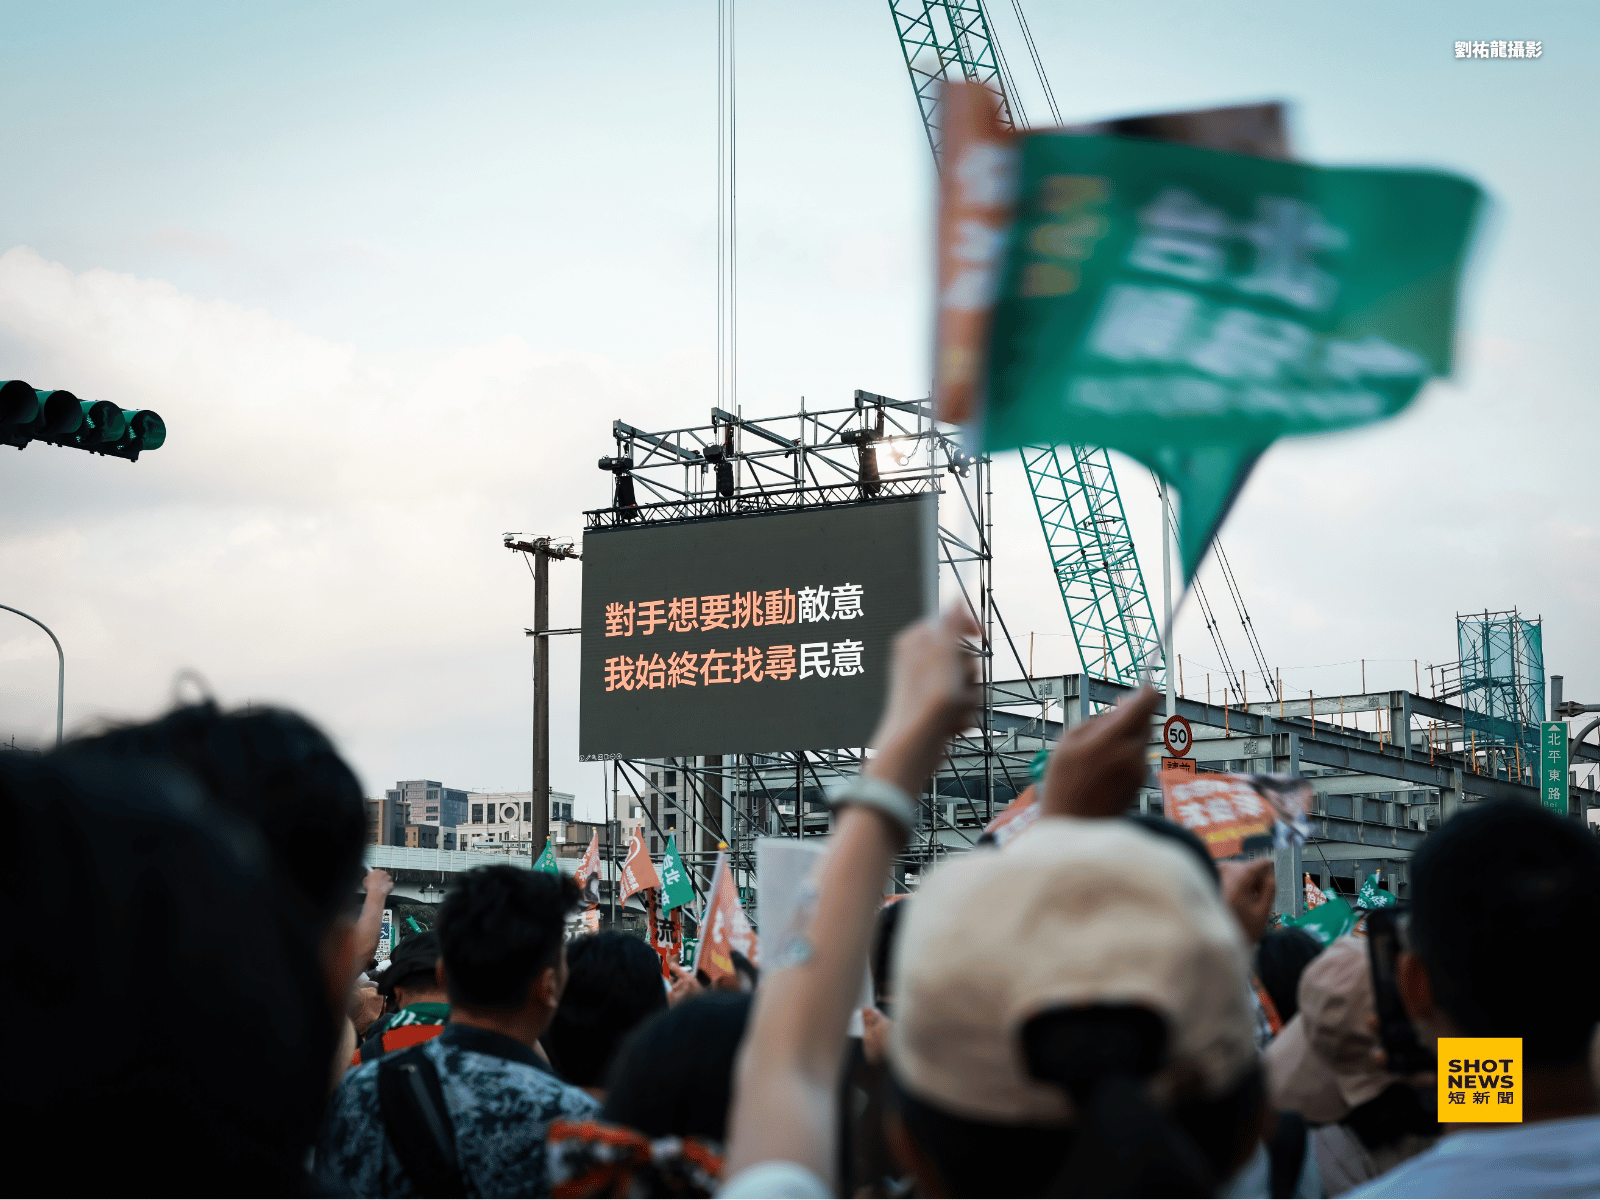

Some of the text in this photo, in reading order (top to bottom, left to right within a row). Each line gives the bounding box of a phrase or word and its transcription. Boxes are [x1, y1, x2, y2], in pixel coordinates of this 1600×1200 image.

[605, 582, 864, 637] 對手想要挑動敵意
[604, 638, 865, 692] 我始終在找尋民意
[1169, 728, 1187, 743] 50
[1547, 732, 1561, 800] 北平東路
